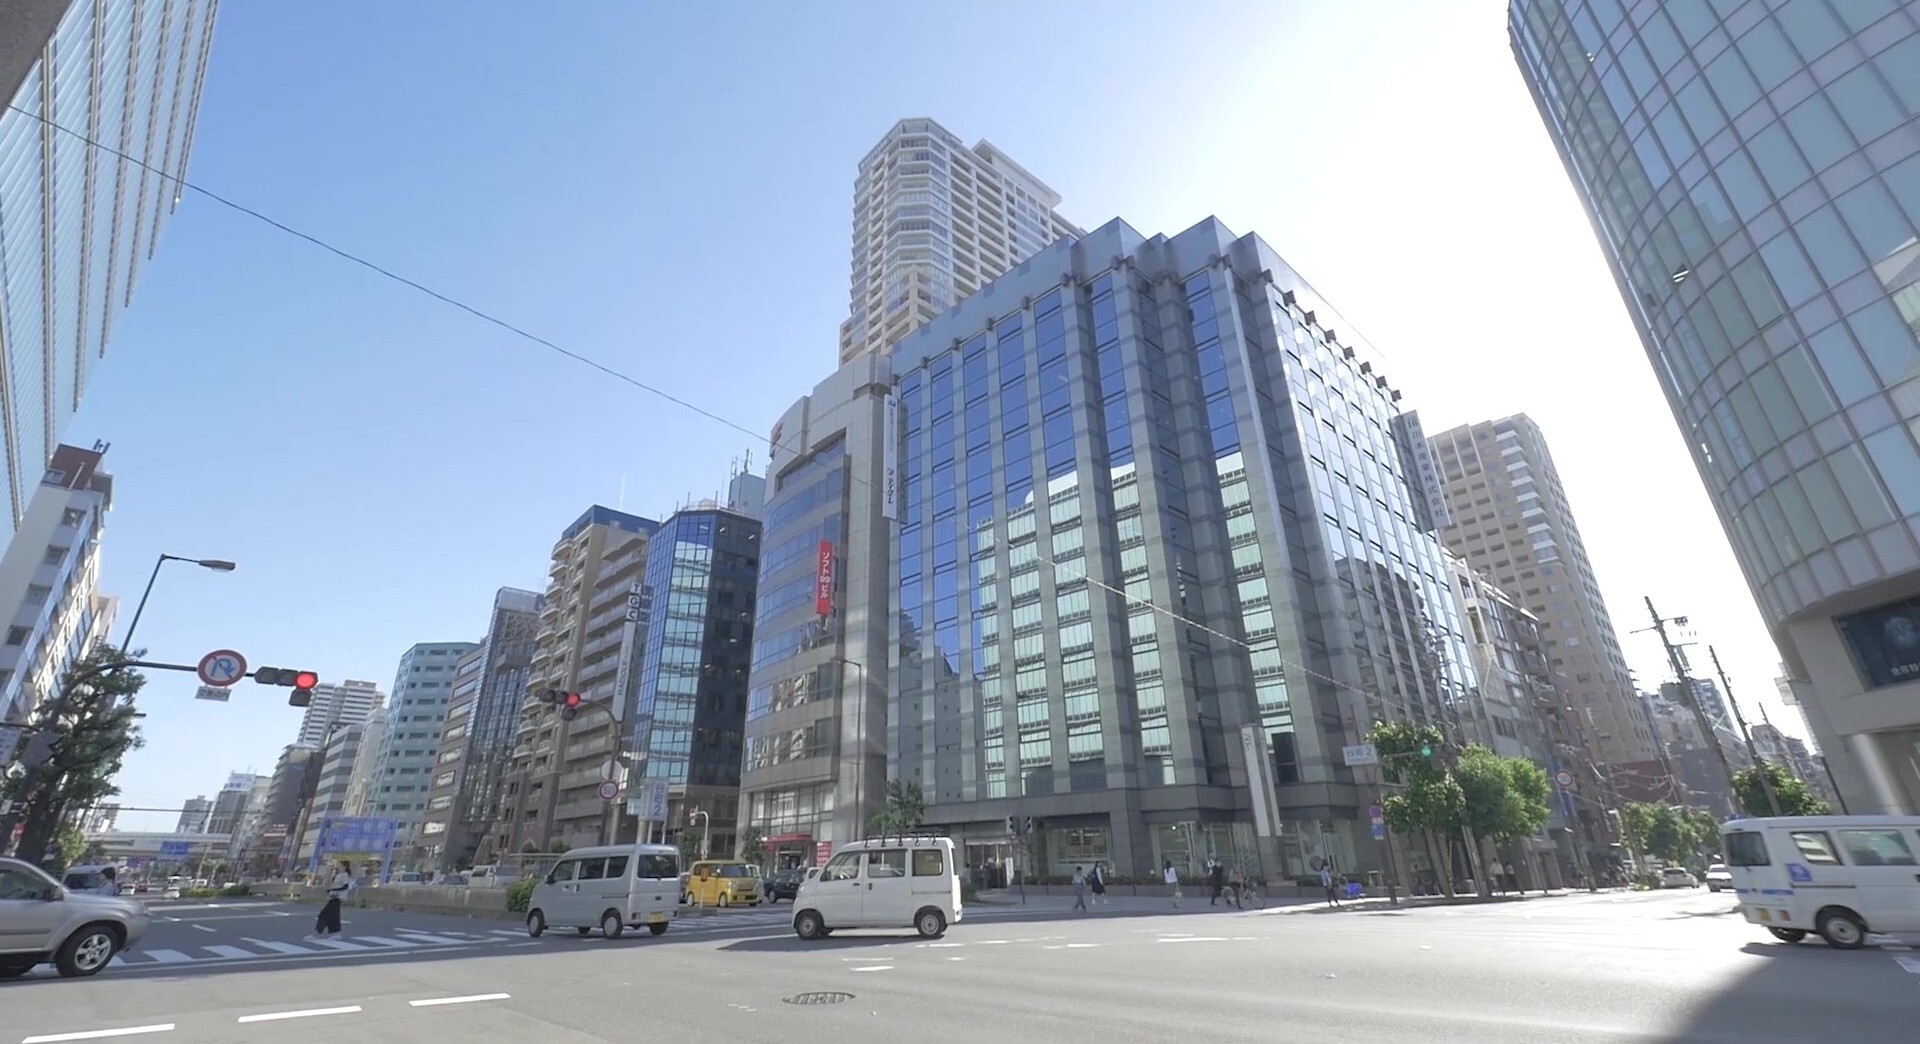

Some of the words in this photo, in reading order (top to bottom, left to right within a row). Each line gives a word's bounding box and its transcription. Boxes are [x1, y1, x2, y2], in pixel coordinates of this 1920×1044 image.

[819, 551, 831, 599] ソフト99ビル
[653, 782, 665, 816] 谷町2
